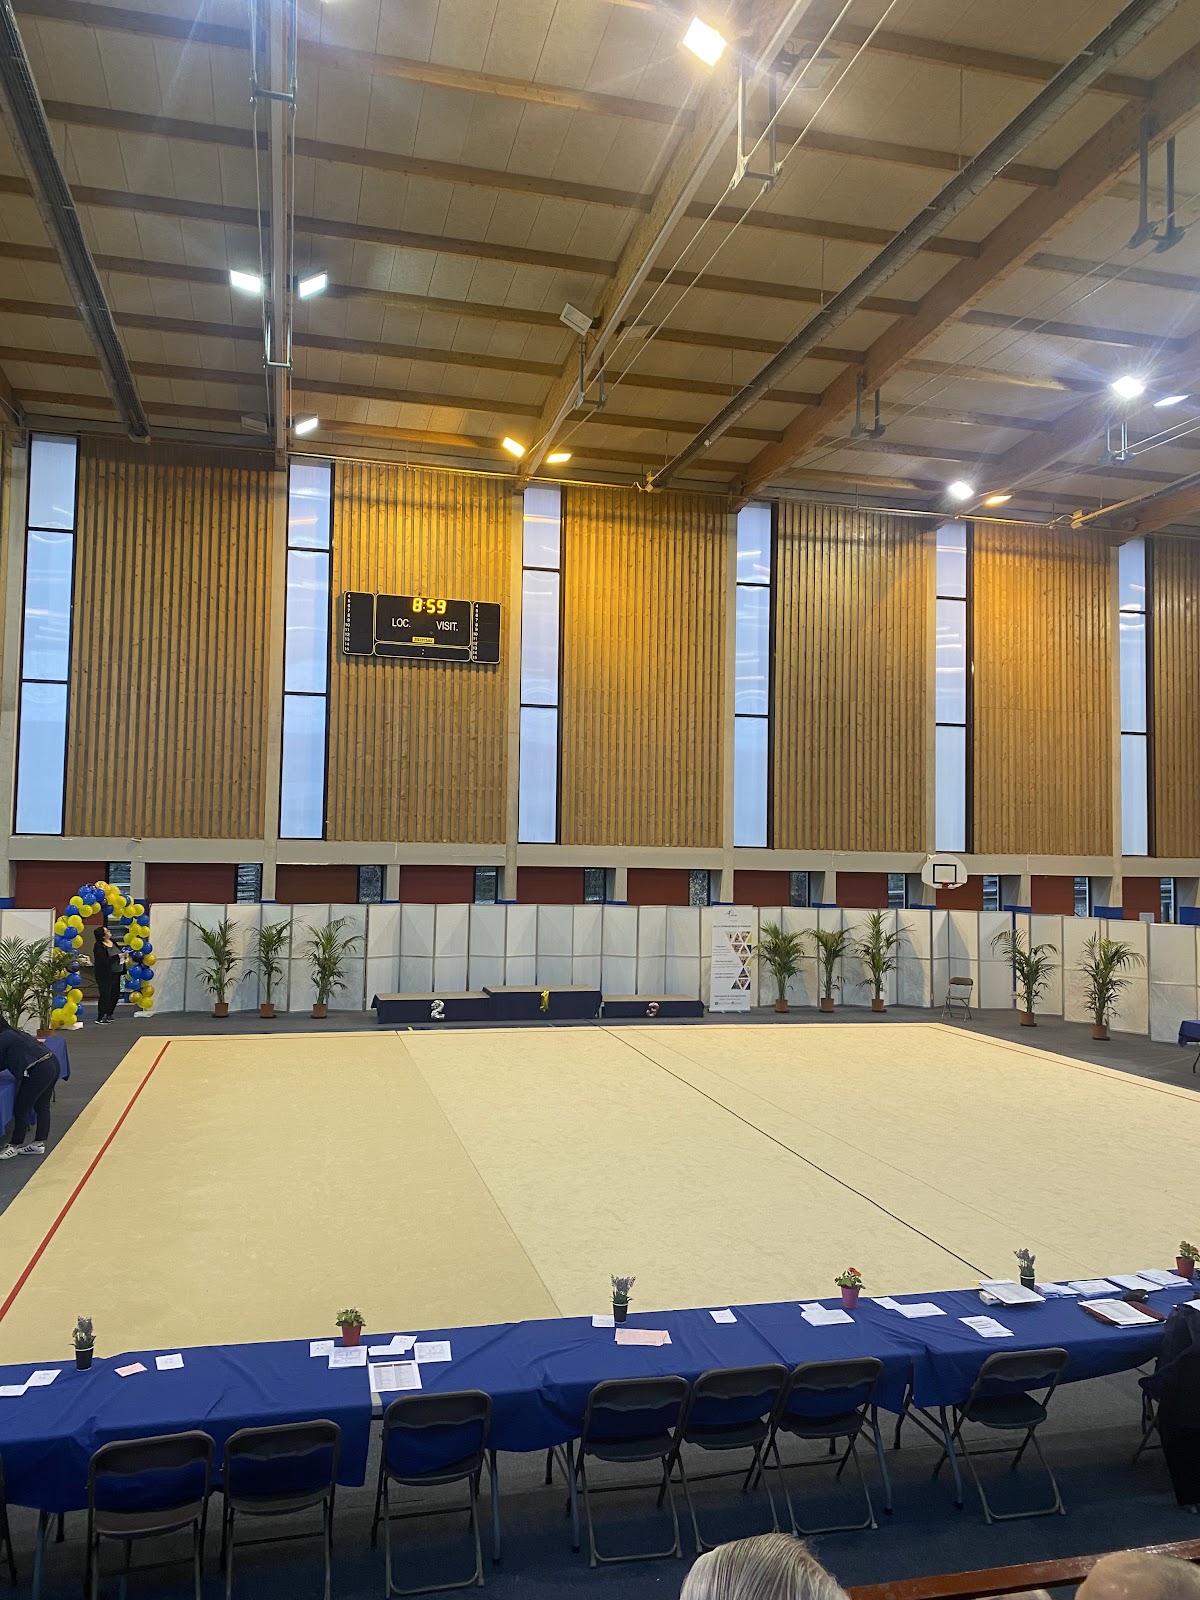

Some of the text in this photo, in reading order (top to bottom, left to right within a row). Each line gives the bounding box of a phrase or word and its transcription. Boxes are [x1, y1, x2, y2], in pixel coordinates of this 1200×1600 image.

[412, 597, 447, 614] 8:59
[391, 617, 411, 628] LOC.
[436, 620, 458, 631] VISIT.
[430, 999, 446, 1019] 2
[645, 1001, 660, 1017] 3
